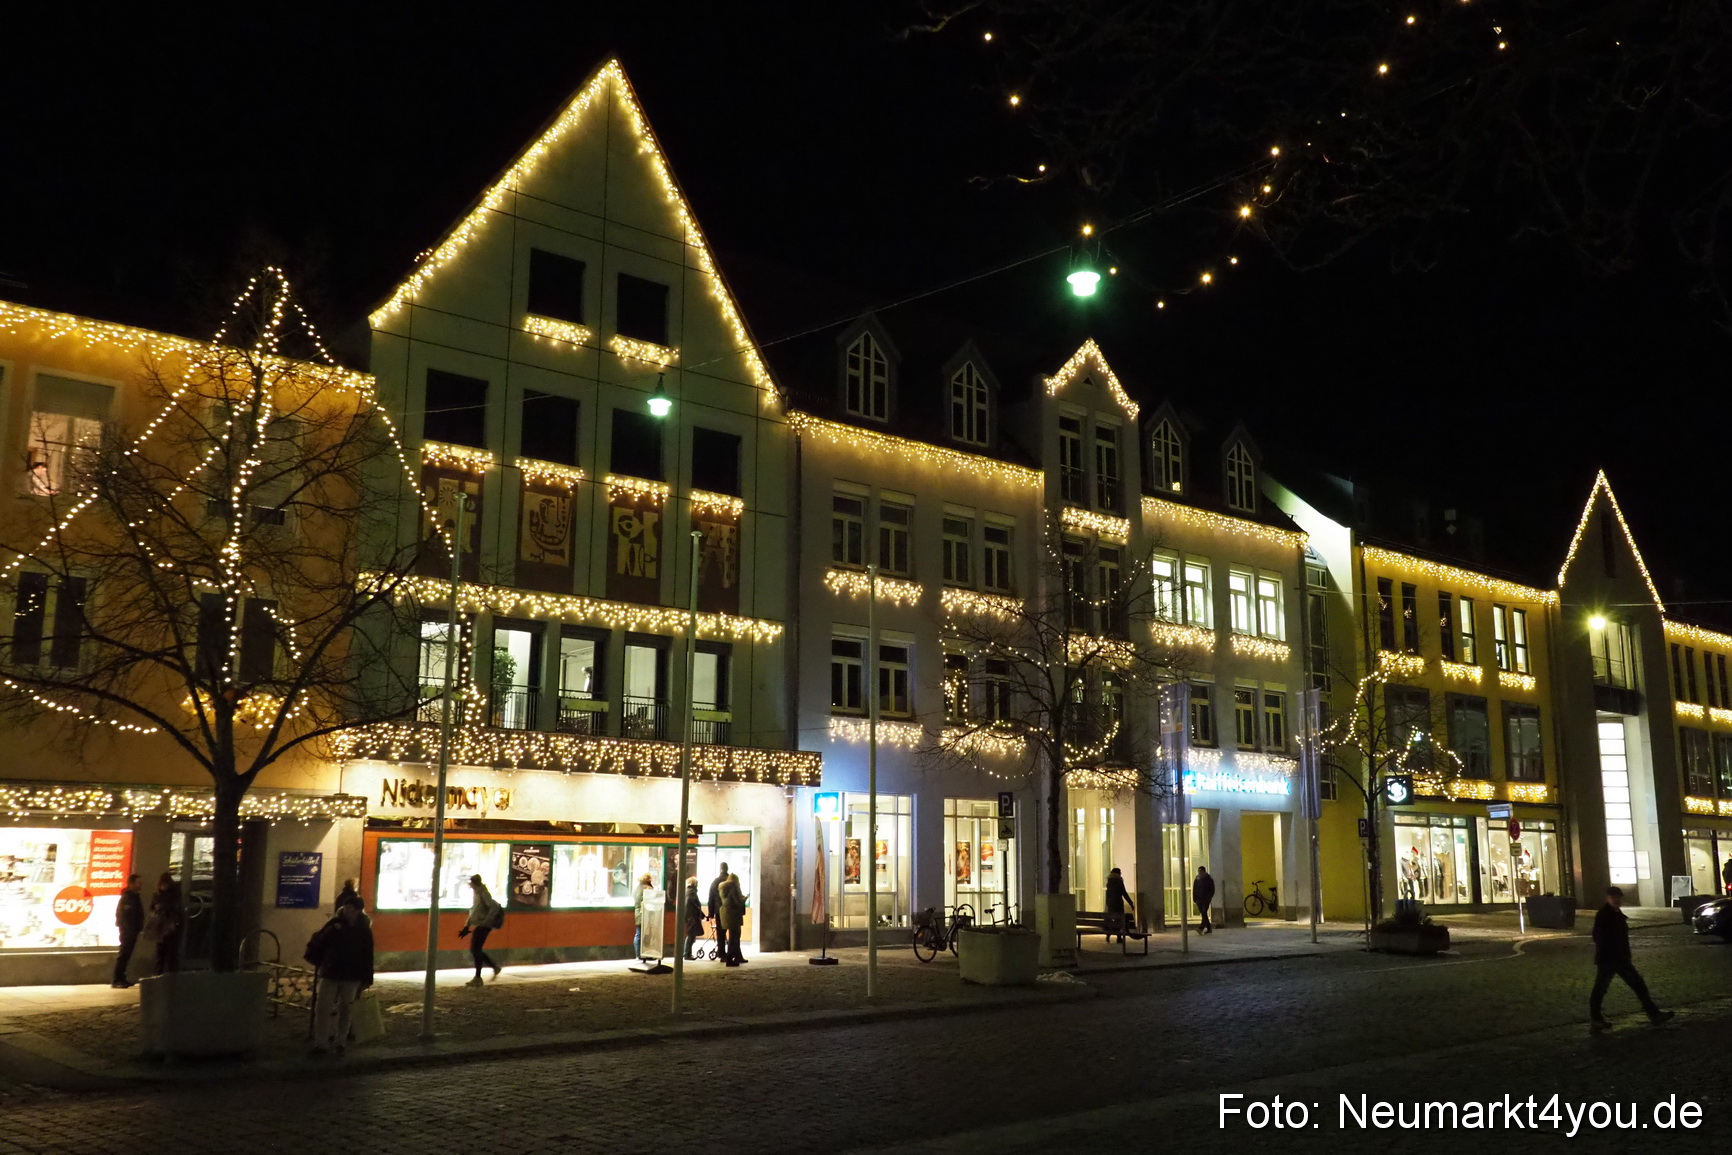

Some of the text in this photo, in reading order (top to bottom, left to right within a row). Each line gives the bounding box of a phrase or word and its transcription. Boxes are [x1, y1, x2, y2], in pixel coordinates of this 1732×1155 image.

[1196, 771, 1291, 795] Raiffeisenbank
[1001, 795, 1010, 814] P
[1359, 821, 1366, 835] P
[90, 870, 123, 879] stark
[53, 899, 92, 912] 50%
